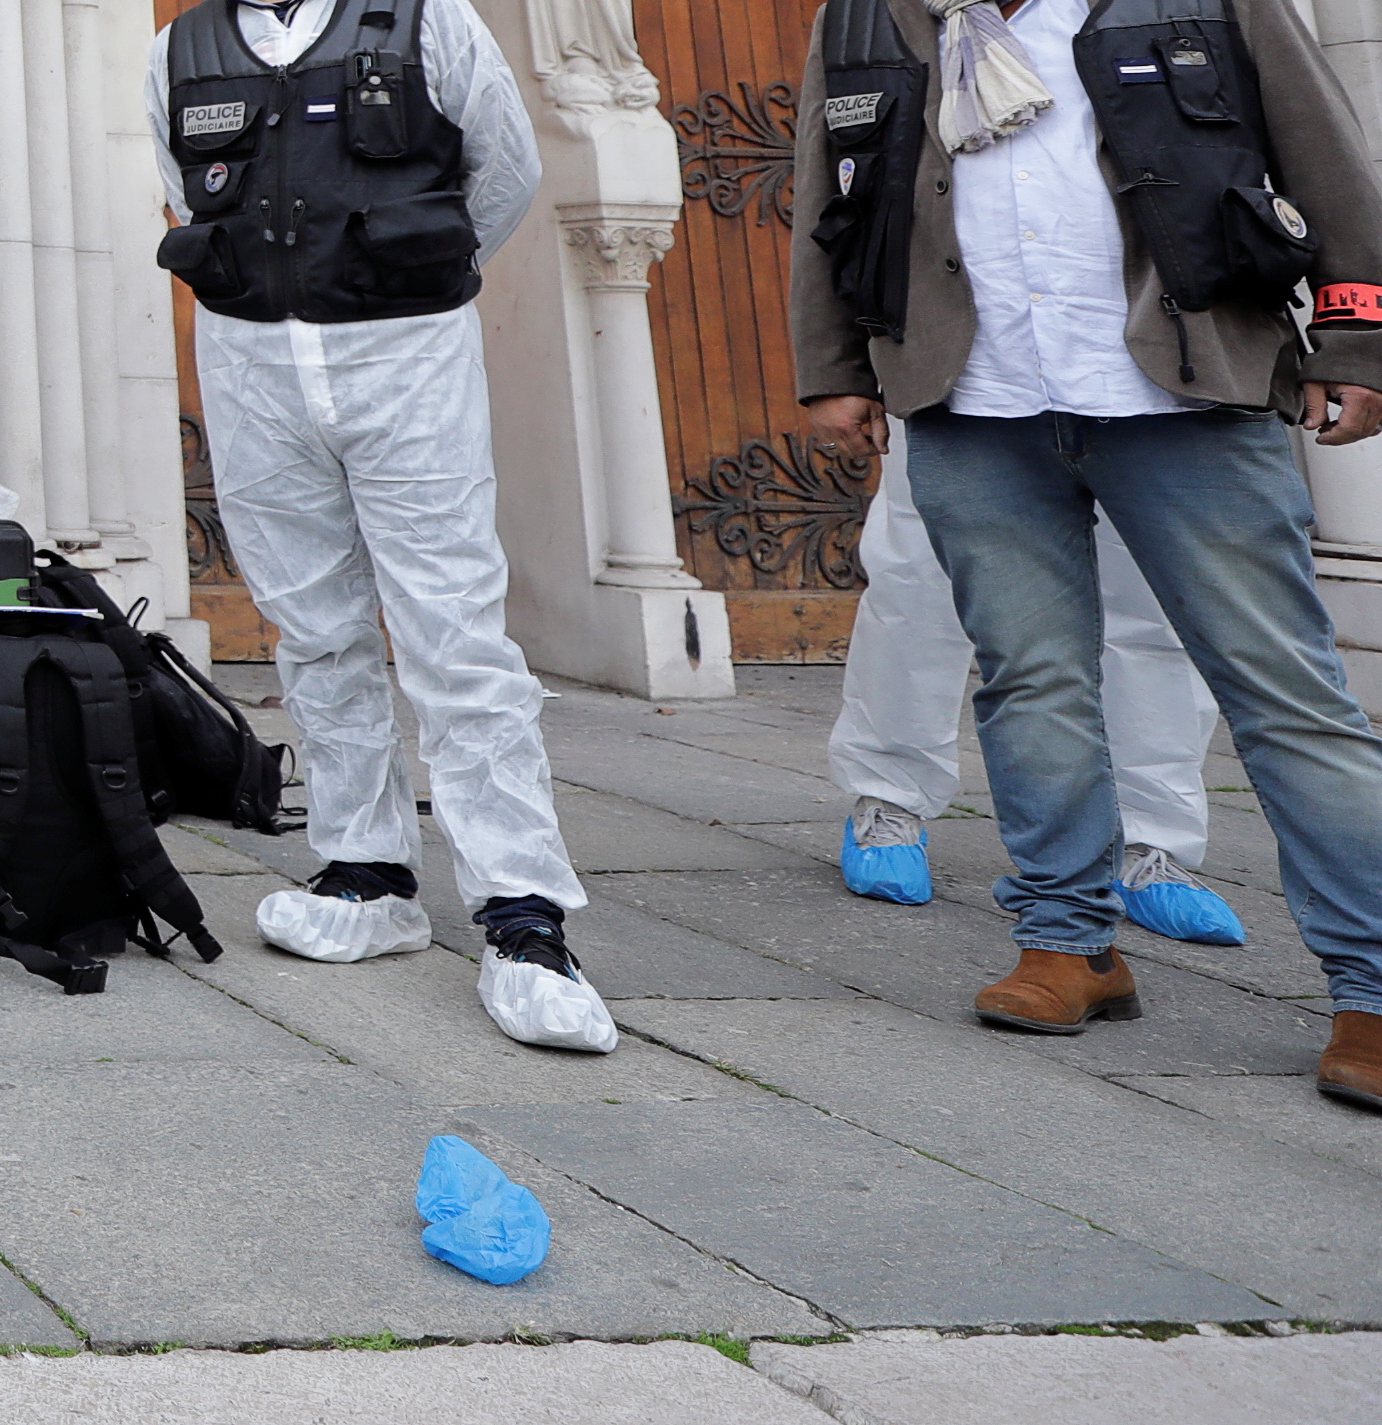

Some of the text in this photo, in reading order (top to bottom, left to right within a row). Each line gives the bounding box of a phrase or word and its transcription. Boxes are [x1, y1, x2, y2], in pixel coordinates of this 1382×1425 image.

[185, 104, 244, 123] POLICE
[827, 94, 880, 114] POLICE
[186, 120, 242, 134] JUDICIAIRE
